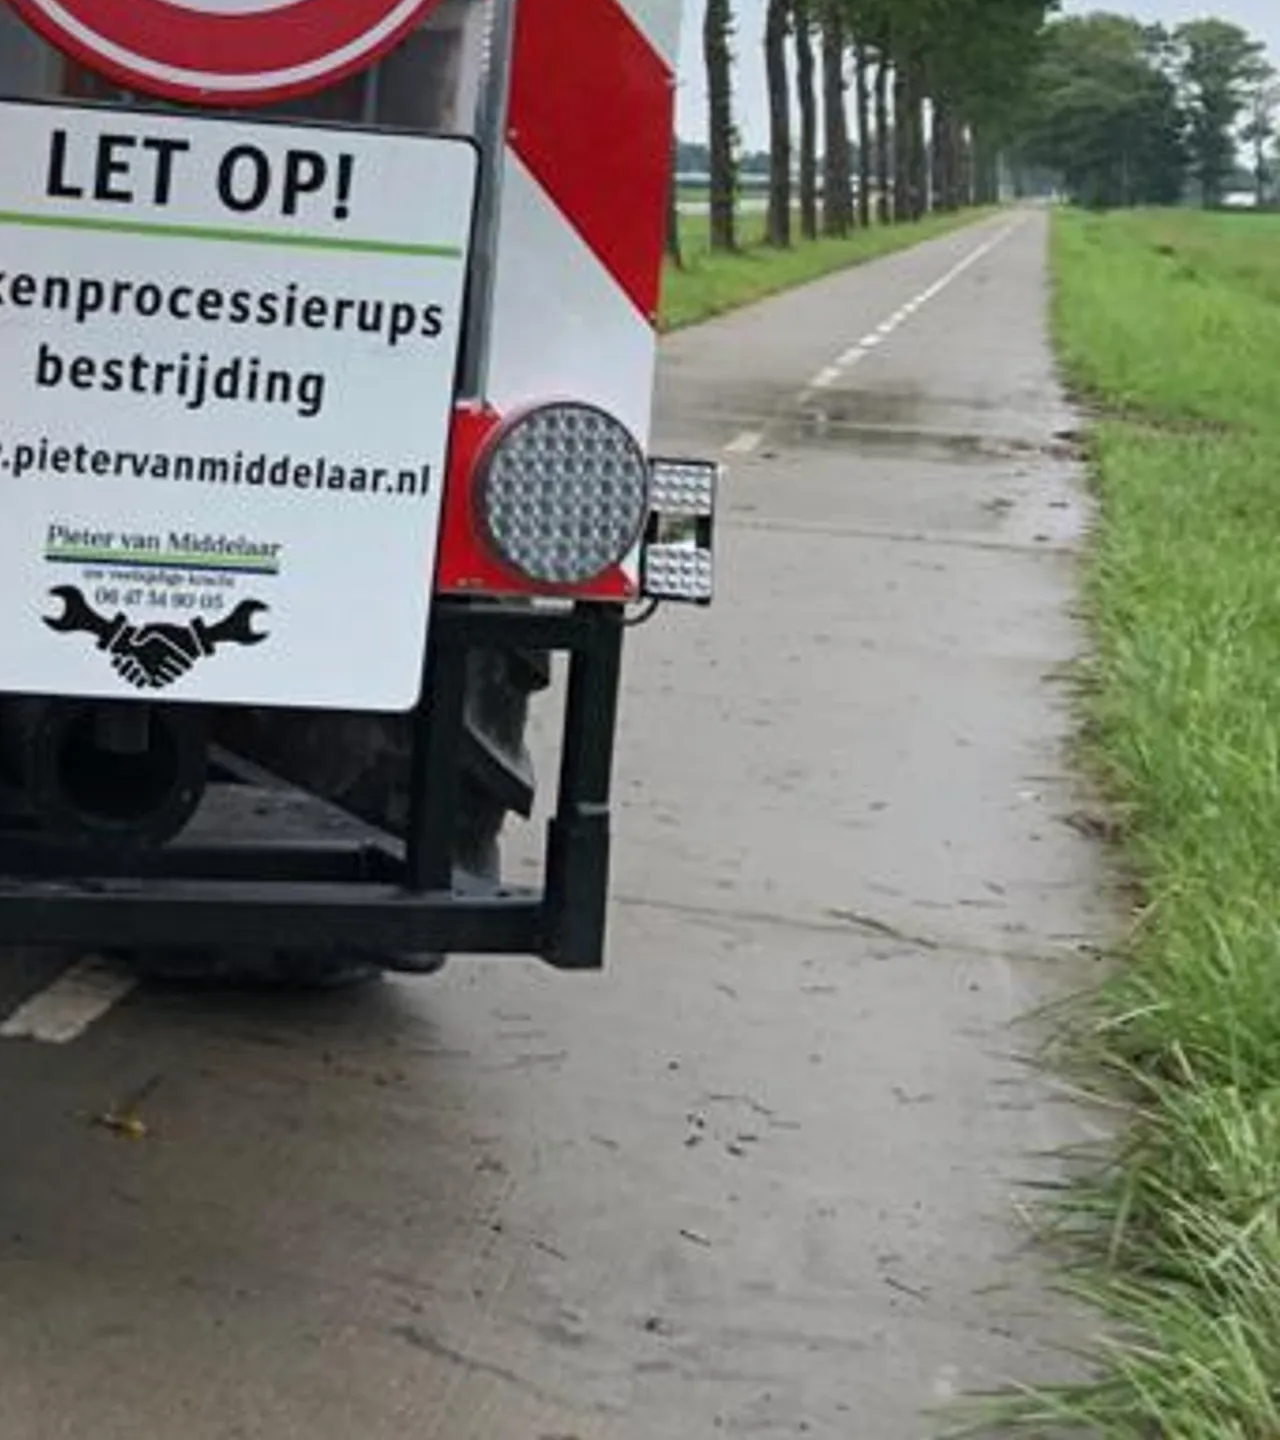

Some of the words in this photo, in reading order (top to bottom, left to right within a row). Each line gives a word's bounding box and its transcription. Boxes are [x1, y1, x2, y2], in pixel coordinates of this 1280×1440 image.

[46, 129, 189, 206] LET
[216, 145, 354, 219] OP!
[37, 345, 325, 416] bestrijding
[48, 525, 113, 546] Pieter
[121, 533, 160, 549] van
[169, 532, 281, 558] Middelaar
